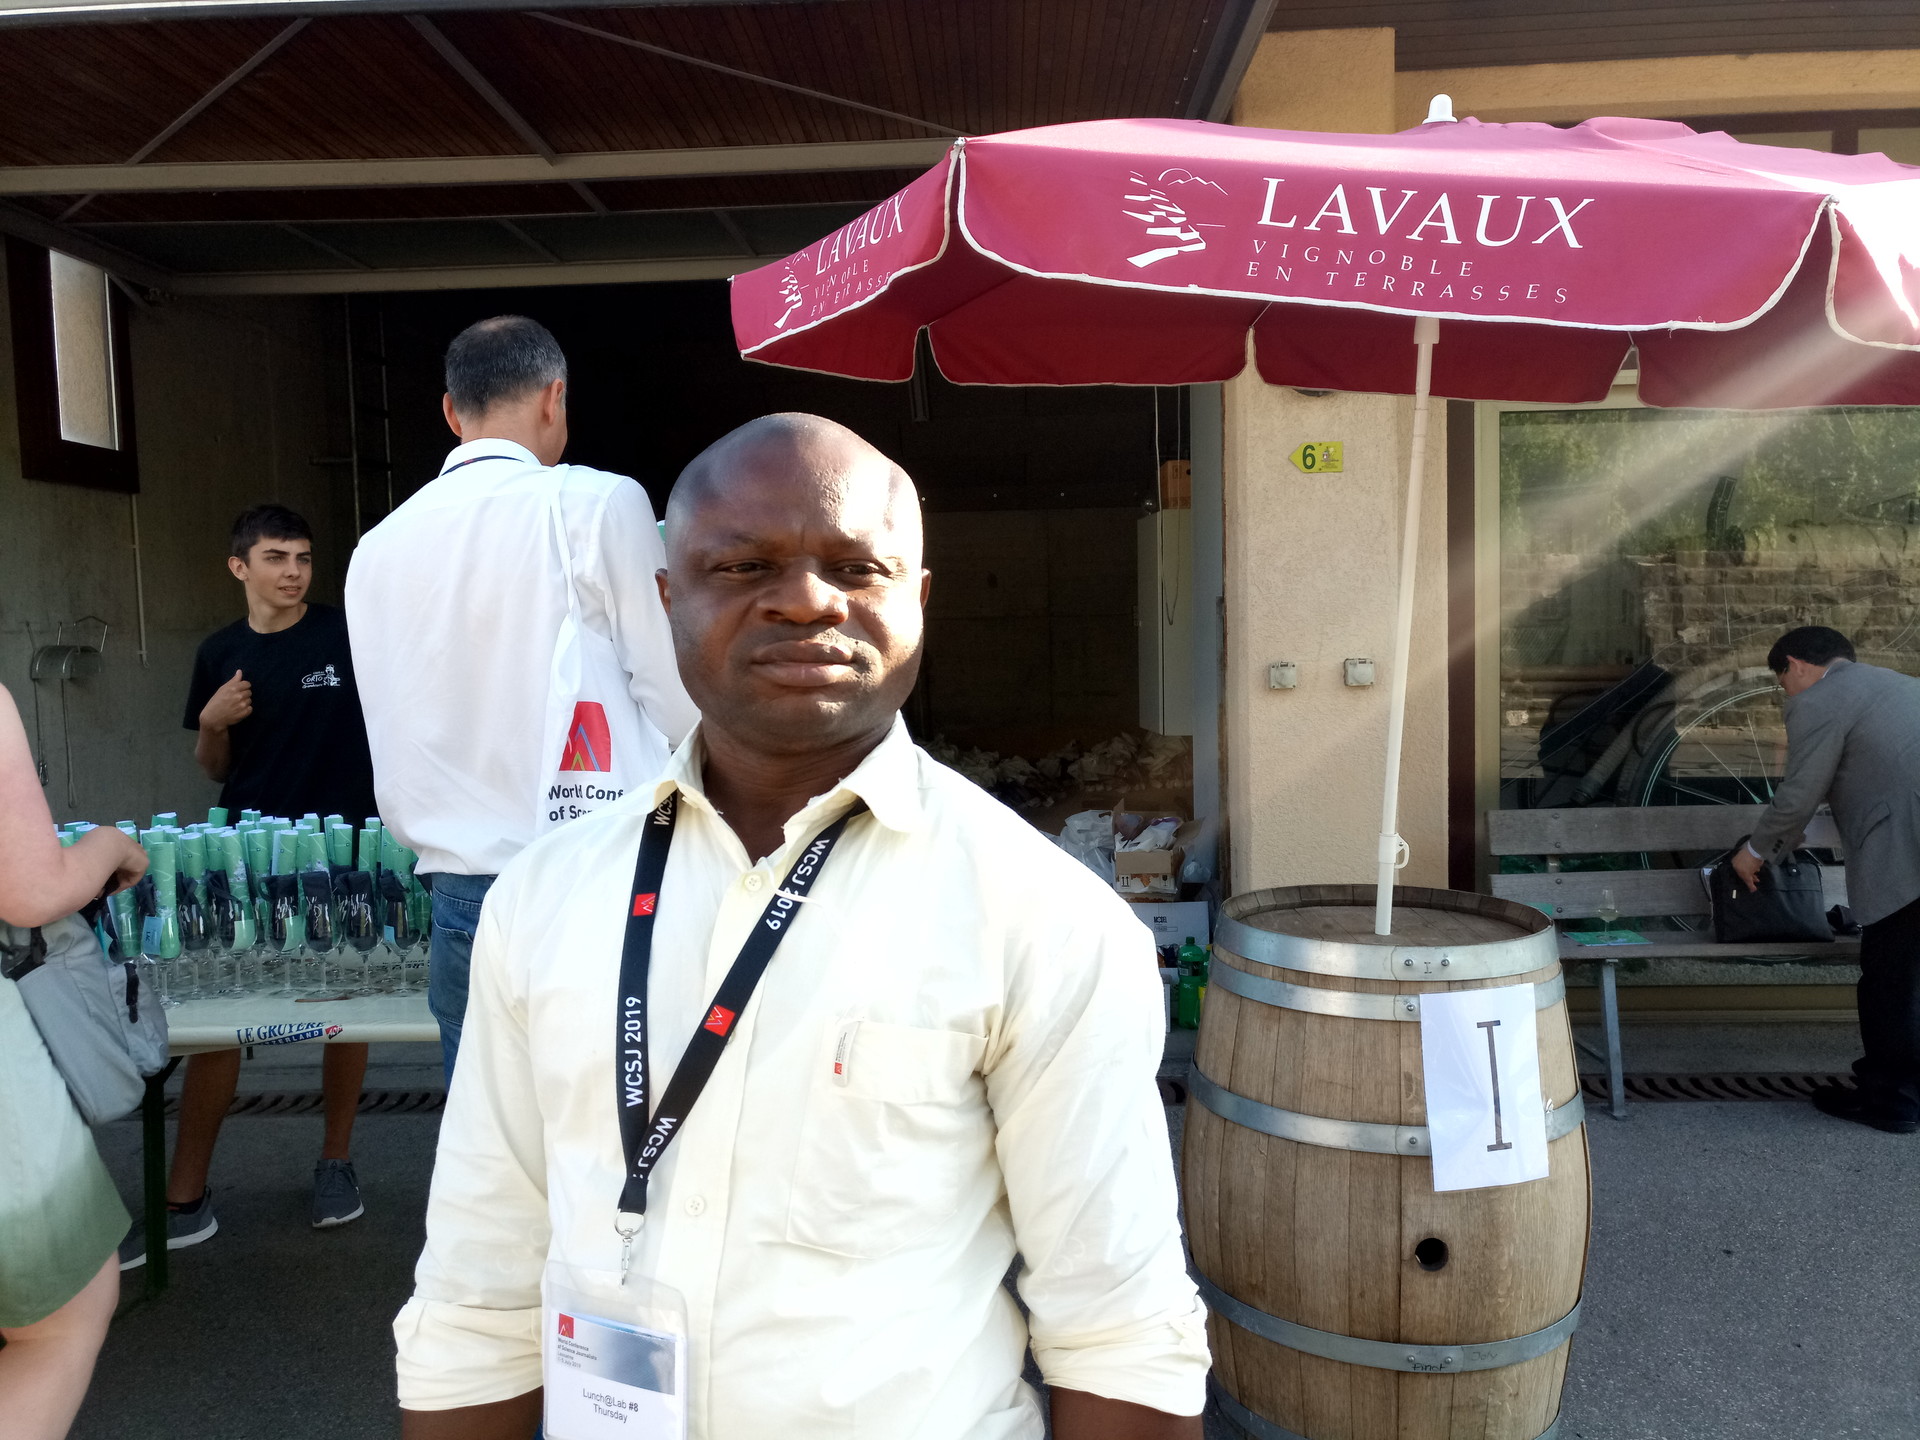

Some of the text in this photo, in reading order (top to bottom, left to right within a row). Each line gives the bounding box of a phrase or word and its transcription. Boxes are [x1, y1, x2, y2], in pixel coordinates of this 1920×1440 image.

[815, 189, 909, 276] LAVAUX
[1257, 177, 1595, 249] LAVAUX
[1252, 239, 1473, 278] VIGNOBLE
[1247, 261, 1568, 304] EN TERRASSES
[1302, 444, 1316, 470] 6
[548, 805, 565, 821] of
[792, 839, 830, 886] WCSJ
[236, 1027, 255, 1045] LE
[624, 996, 643, 1108] WCSJ 2019
[1476, 1020, 1513, 1152] I
[638, 1117, 677, 1168] WCSJ
[582, 1387, 639, 1412] Lunch@Lab #8
[593, 1402, 628, 1424] Thursday
